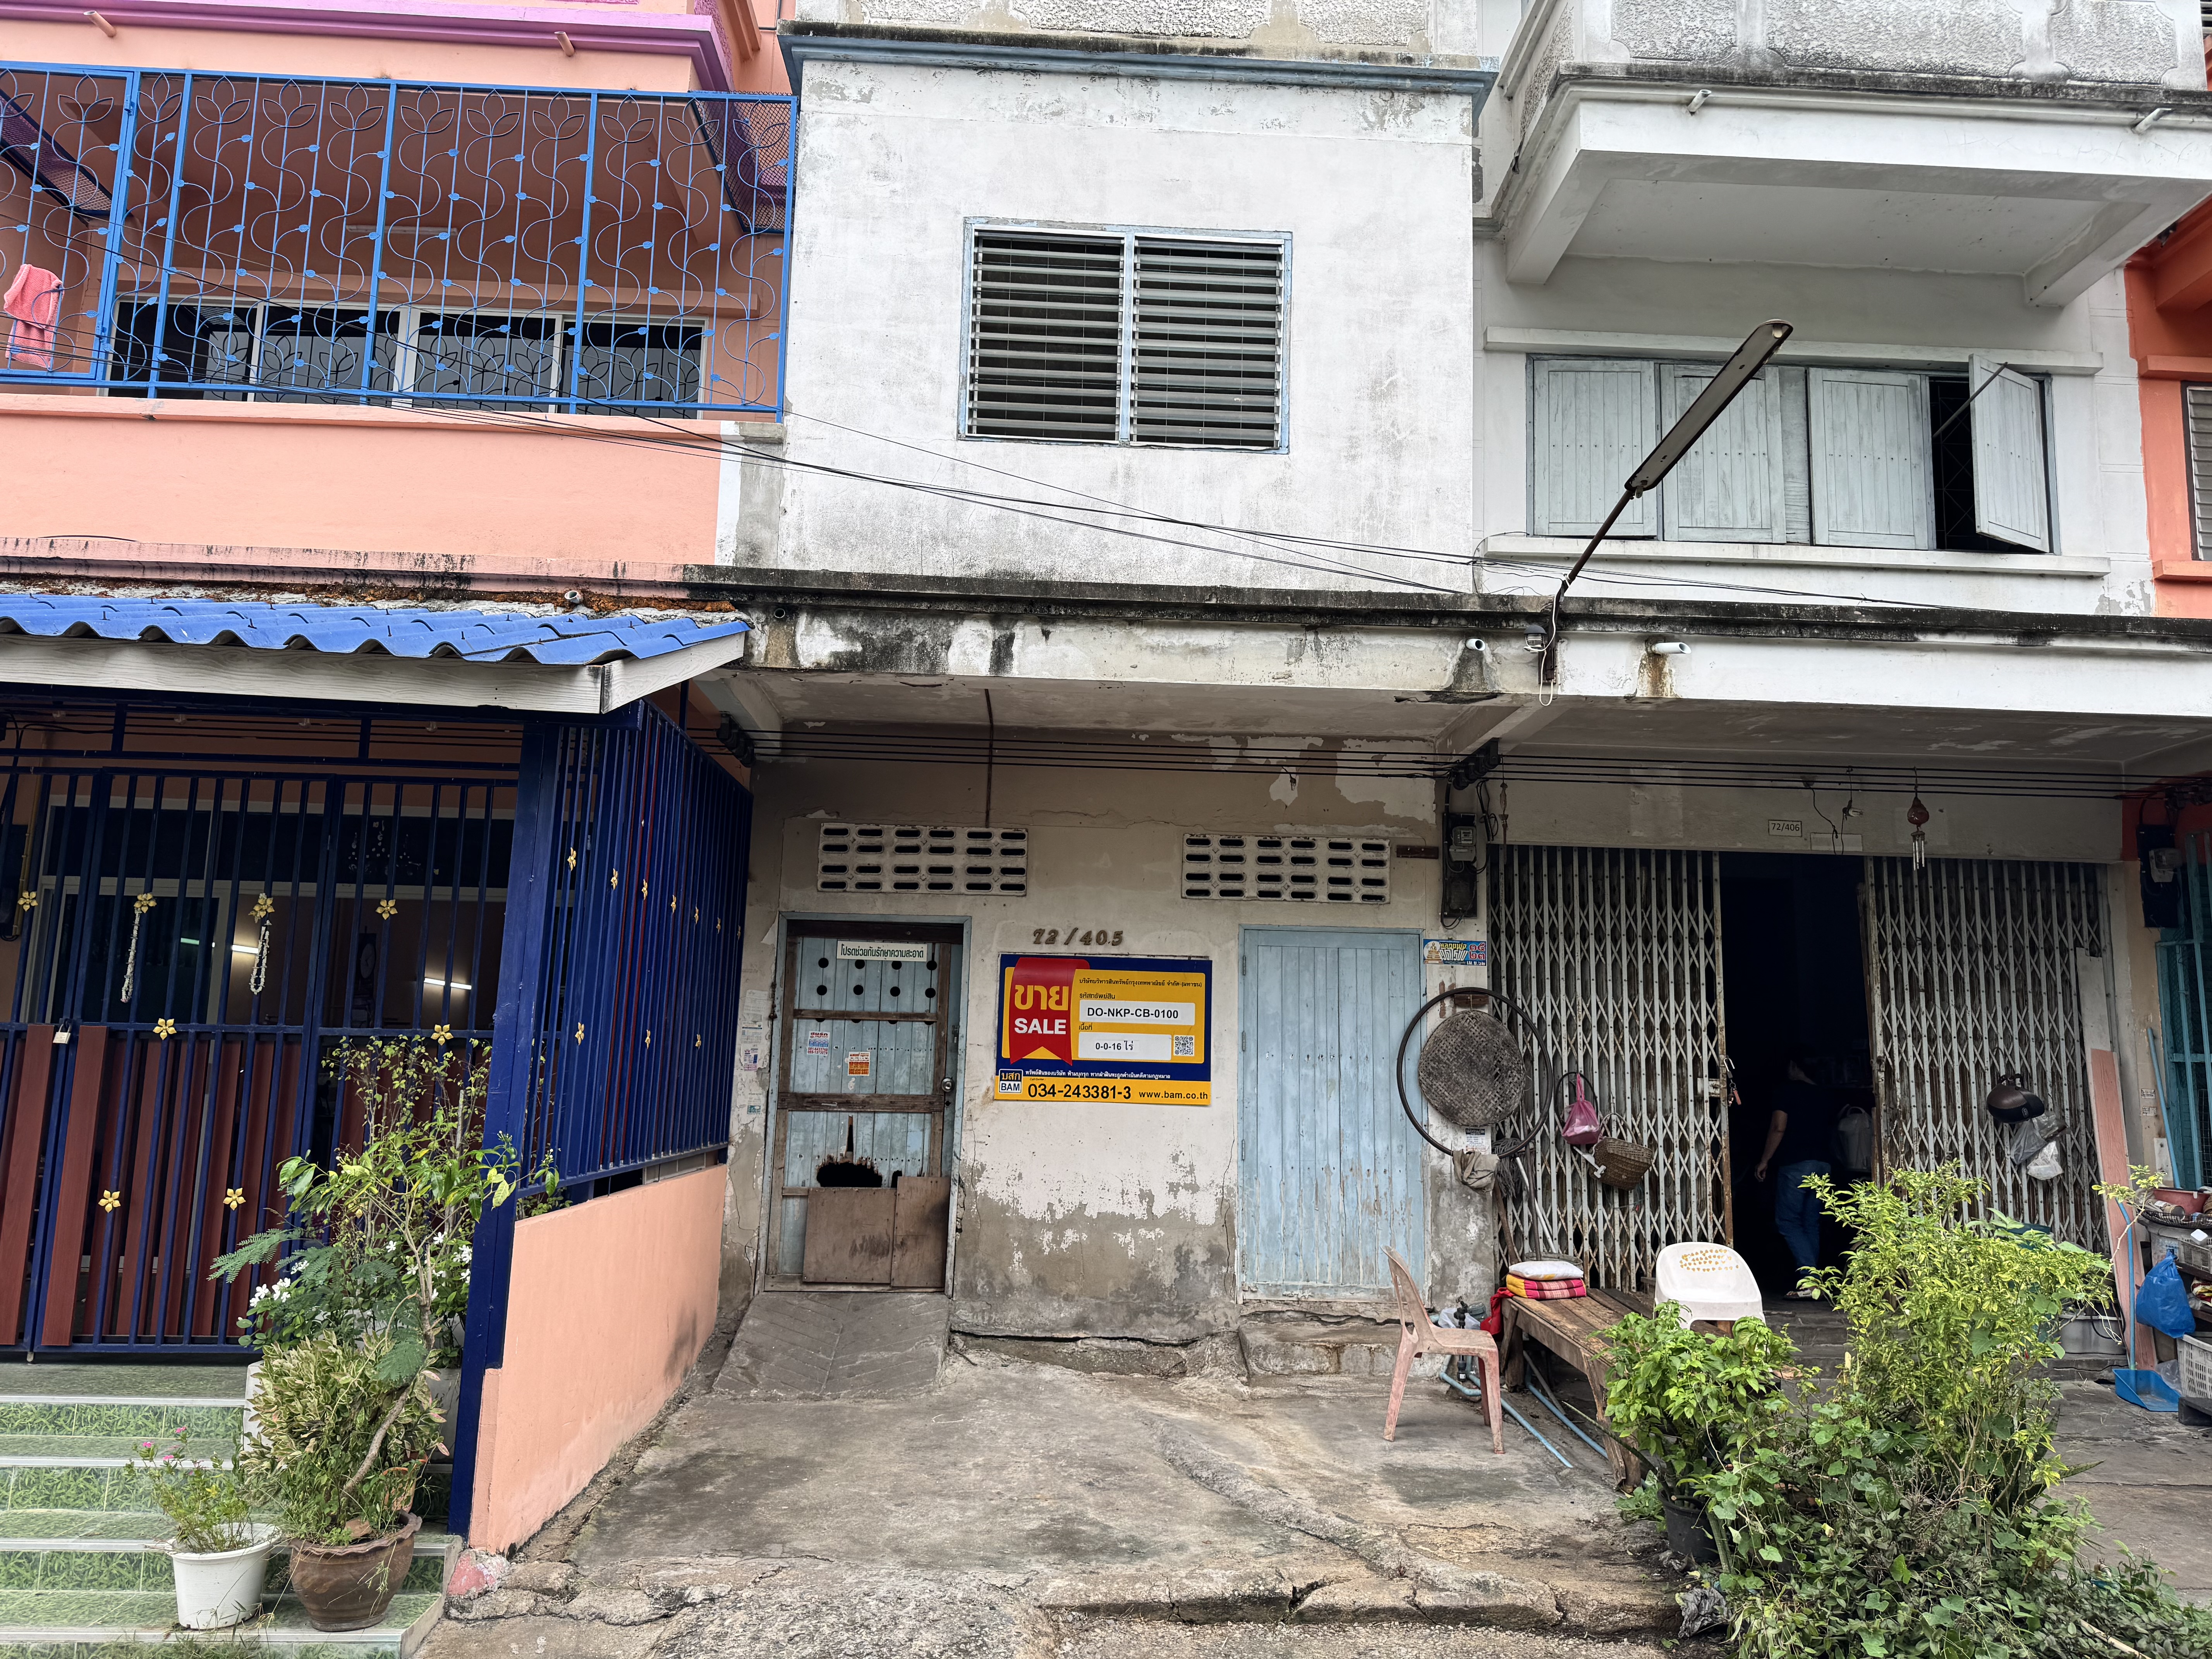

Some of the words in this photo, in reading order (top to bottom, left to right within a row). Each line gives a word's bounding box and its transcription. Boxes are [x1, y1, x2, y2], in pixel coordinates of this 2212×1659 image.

[1771, 823, 1800, 832] 72/406
[1033, 927, 1123, 946] 72/405
[841, 943, 924, 958] โปรดช่วยกันรักษาความสะอาด
[1014, 984, 1068, 1011] ขาย
[1087, 1007, 1179, 1019] DO-NKP-CB-0100
[1014, 1018, 1066, 1034] SALE
[1079, 1022, 1093, 1030] เนื้อที่
[1095, 1042, 1122, 1051] 0-0-16
[1124, 1041, 1133, 1051] ไร่
[1001, 1072, 1020, 1081] บสก
[1001, 1082, 1020, 1091] BAM
[1028, 1083, 1132, 1099] 034-243381-3
[1139, 1090, 1208, 1099] www.bam.co.th
